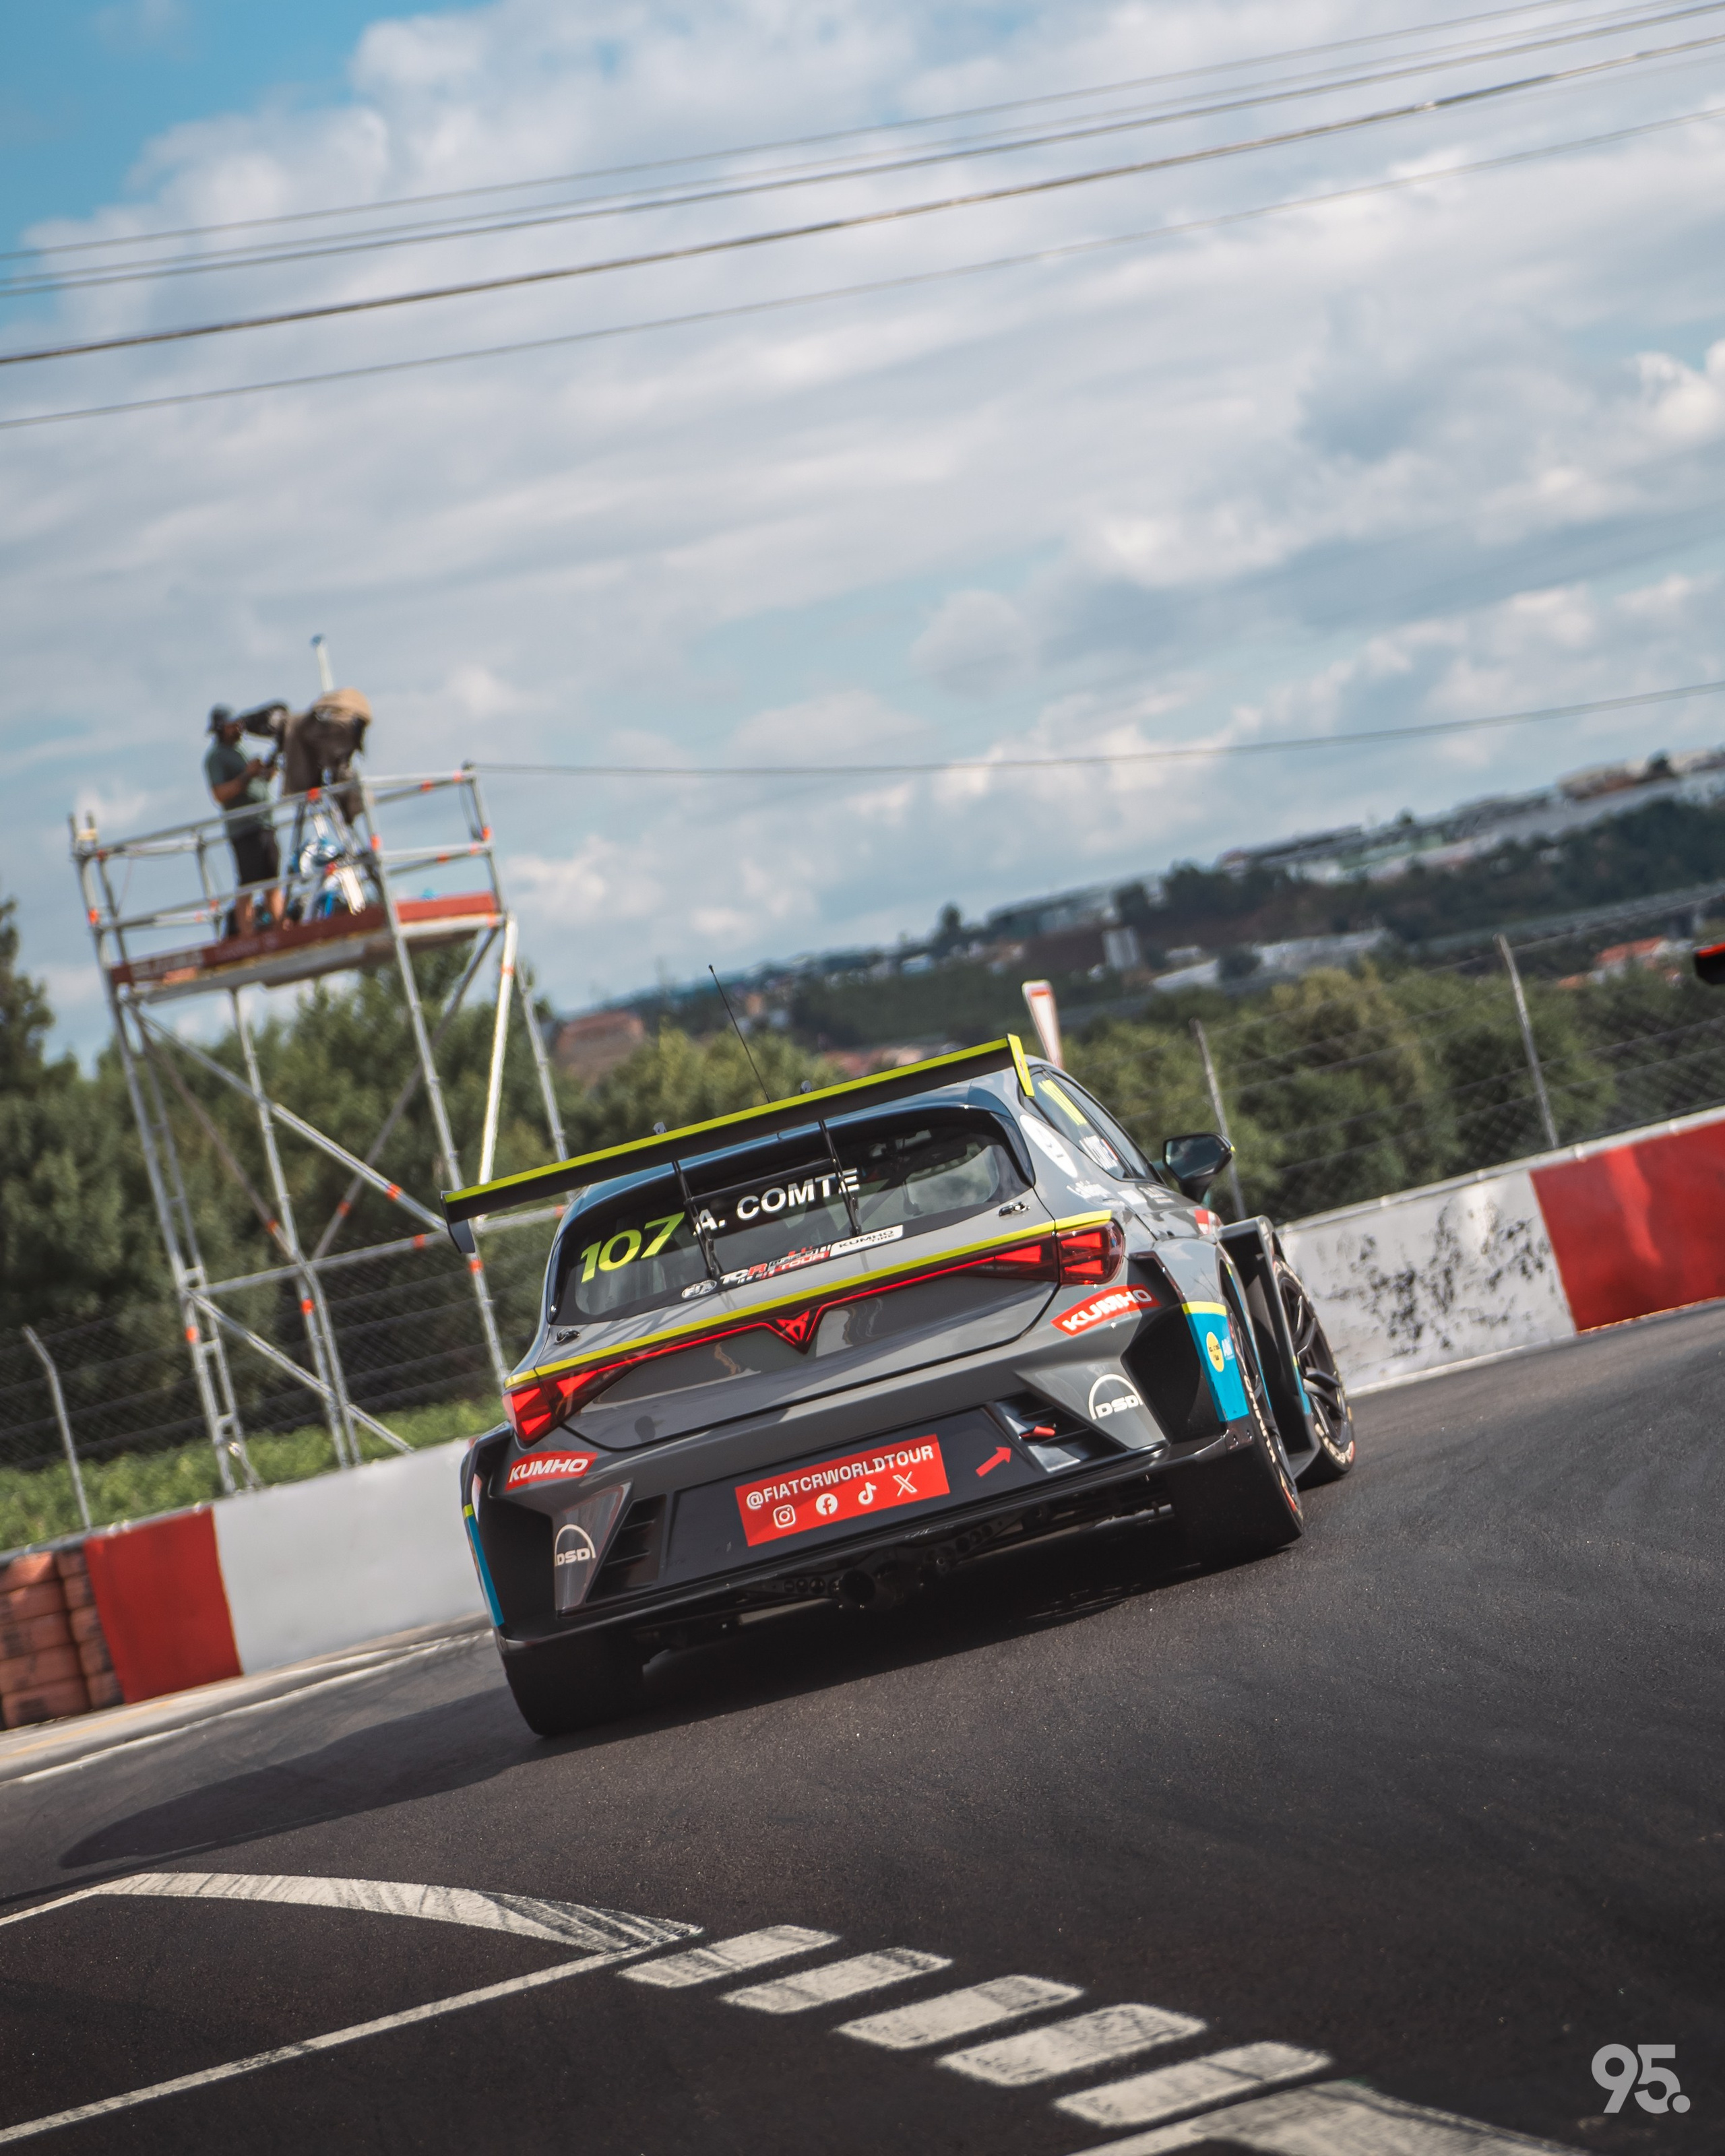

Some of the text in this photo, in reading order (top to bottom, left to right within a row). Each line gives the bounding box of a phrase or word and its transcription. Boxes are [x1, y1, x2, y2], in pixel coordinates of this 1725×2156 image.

[693, 1168, 860, 1236] A. COMTE
[581, 1211, 685, 1283] 107
[840, 1230, 894, 1248] KUMHO
[780, 1253, 825, 1270] TOUR
[720, 1263, 767, 1284] TCR
[1062, 1290, 1152, 1331] KUMHO
[1095, 1395, 1139, 1418] DSD
[509, 1459, 588, 1482] KUMHO
[746, 1445, 934, 1510] @FIATCRWORLDTOUR
[557, 1548, 590, 1566] DSD
